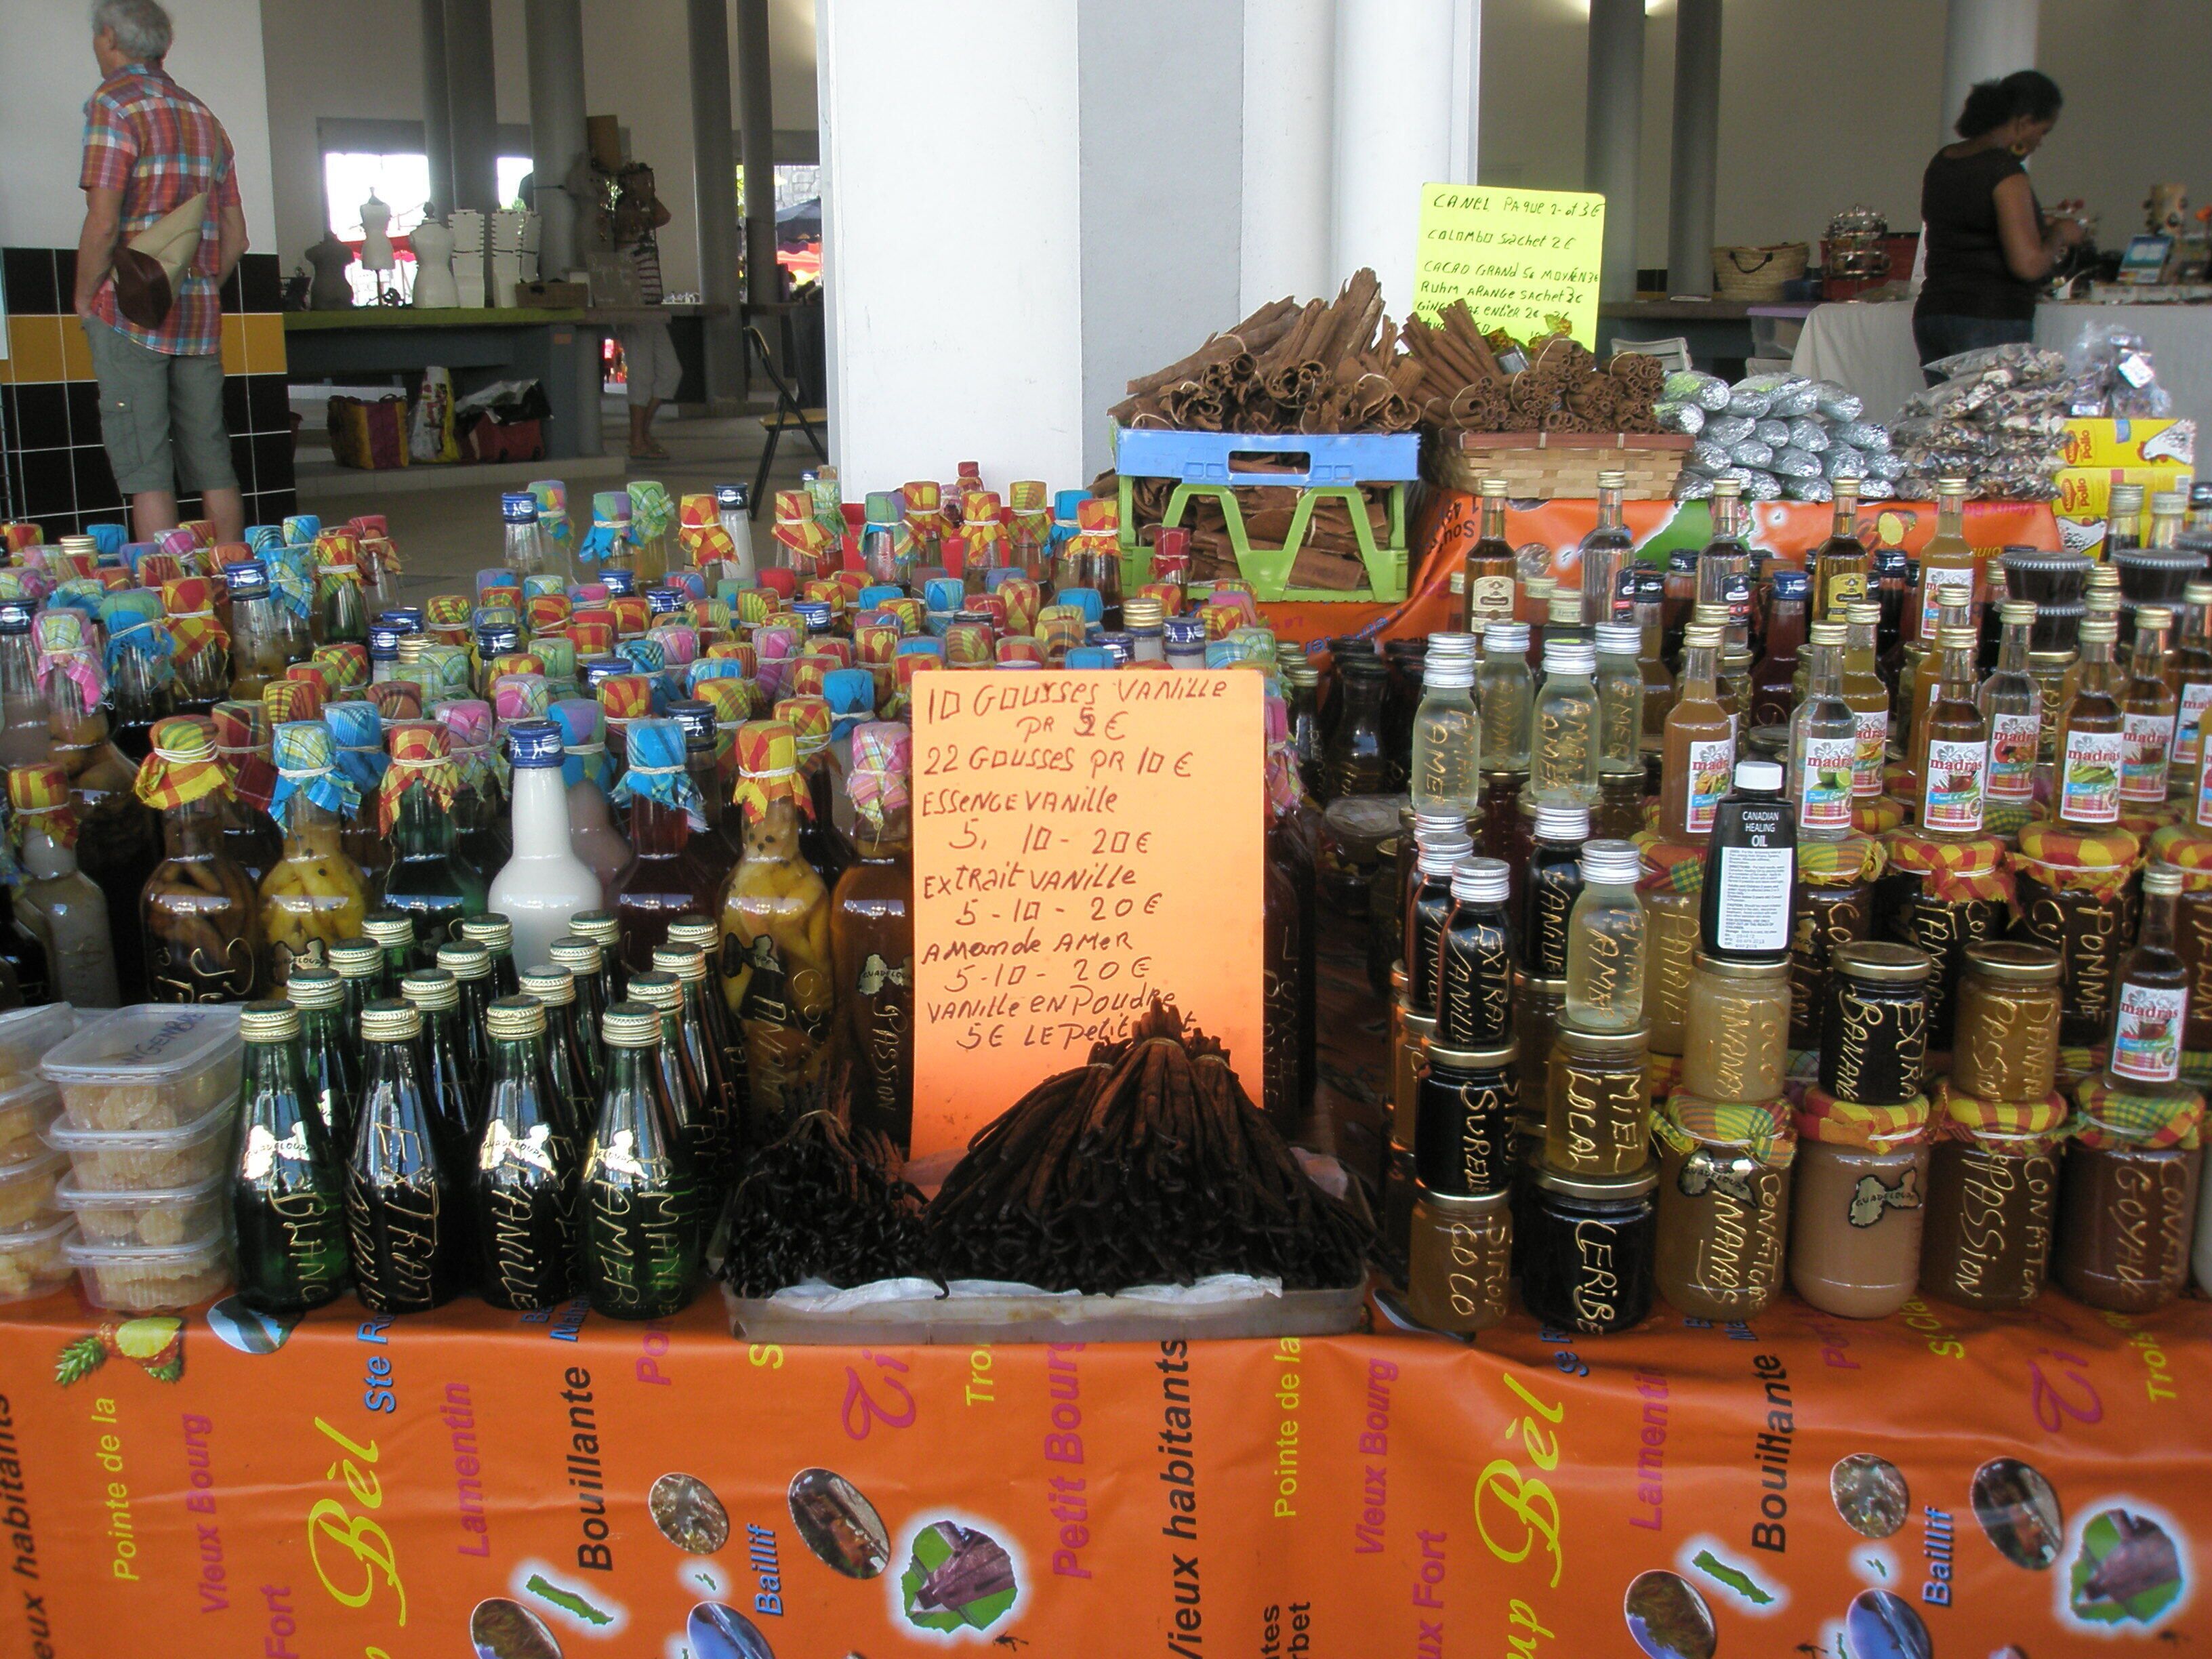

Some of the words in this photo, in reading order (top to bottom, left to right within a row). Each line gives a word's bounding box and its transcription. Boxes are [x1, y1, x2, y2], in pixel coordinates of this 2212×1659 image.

[1424, 260, 1470, 274] CACAO
[928, 687, 961, 724] 10
[923, 745, 959, 776] 22
[1692, 758, 1728, 771] madr
[1929, 758, 1983, 771] madras
[1742, 811, 1779, 821] CANADIAN
[1745, 823, 1776, 833] HEALING
[1751, 834, 1768, 847] OIL
[2121, 1002, 2178, 1019] madras
[91, 1397, 117, 1424] la
[1275, 1372, 1300, 1410] de
[1359, 1357, 1399, 1458] Bourg
[95, 1432, 125, 1473] de
[181, 1412, 218, 1517] Bourg
[439, 1382, 491, 1559] Lamentin
[561, 1365, 615, 1573] Bouillante
[1154, 1338, 1200, 1542] habitants
[1273, 1418, 1298, 1519] Pointe
[1751, 1353, 1795, 1553] Bouillante
[102, 1481, 140, 1582] Pointe
[1047, 1475, 1093, 1581] Petit
[1354, 1465, 1388, 1555] Vieux
[197, 1525, 230, 1615] Vieux
[747, 1522, 783, 1616] Baillif
[1412, 1528, 1448, 1610] Fort
[1922, 1505, 1954, 1607] Baillif
[259, 1584, 300, 1659] Fort
